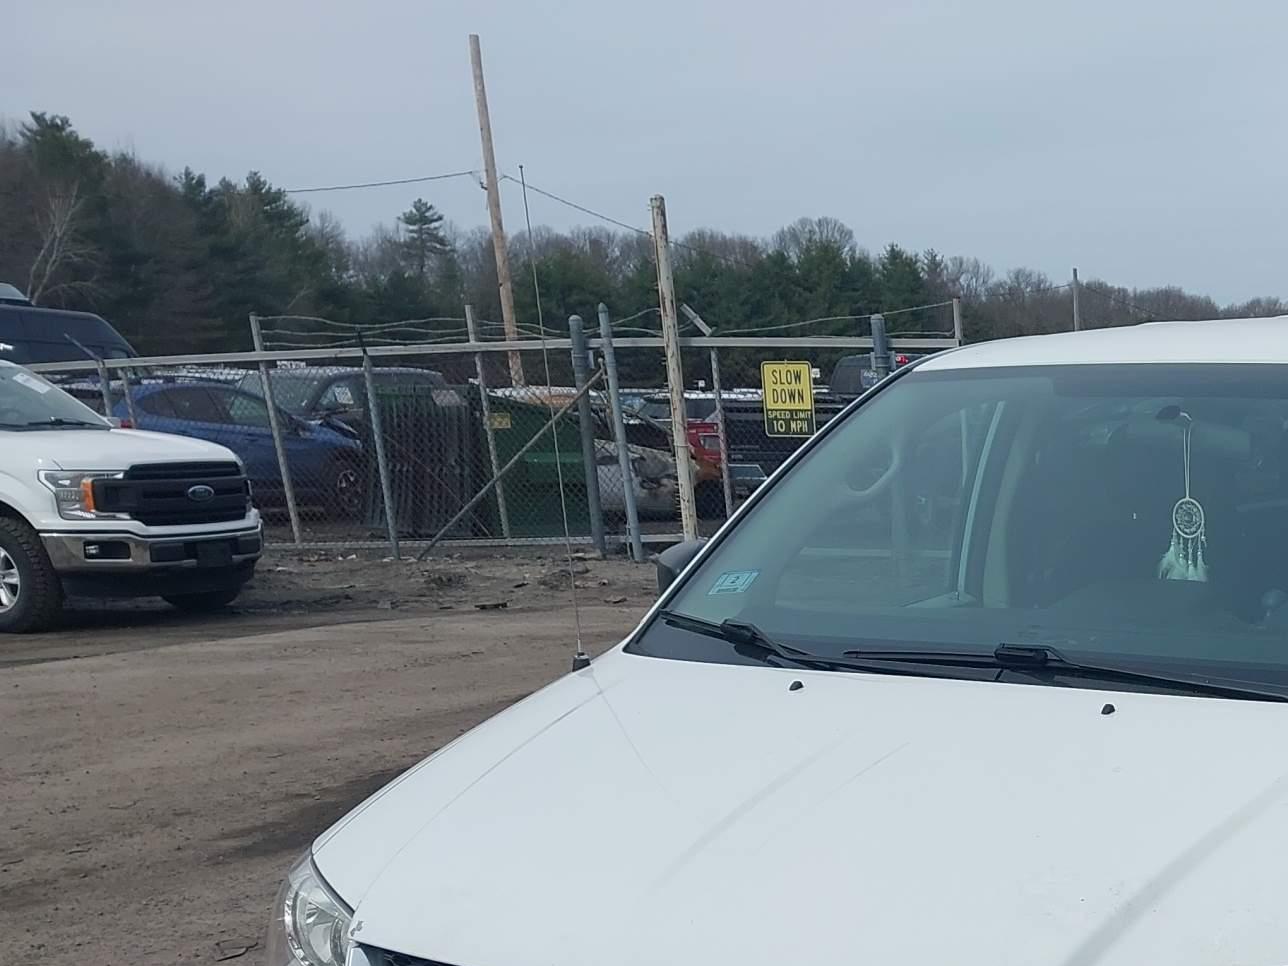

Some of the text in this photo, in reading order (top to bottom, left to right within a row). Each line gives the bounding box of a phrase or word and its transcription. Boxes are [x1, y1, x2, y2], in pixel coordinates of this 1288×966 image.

[771, 369, 802, 385] SLOW
[772, 388, 805, 405] DOWN
[767, 410, 812, 419] SPEED LIMIT
[773, 420, 808, 433] 10 MPH
